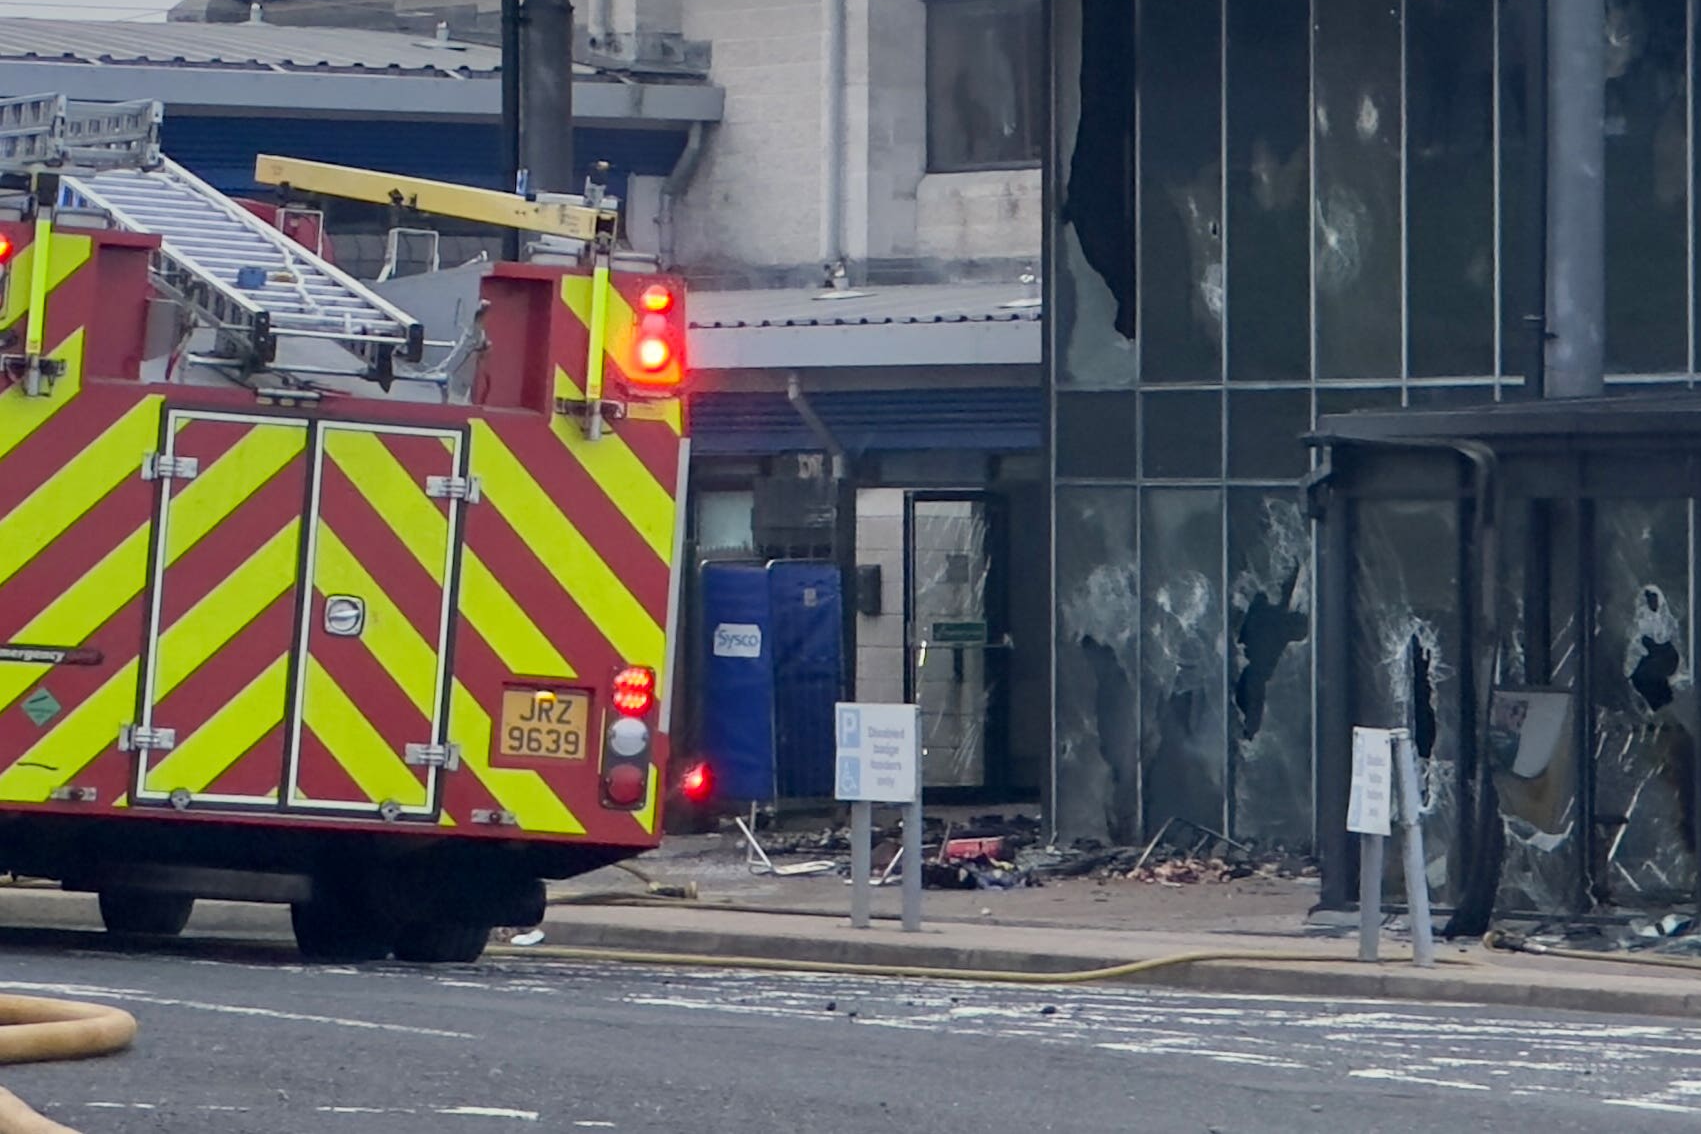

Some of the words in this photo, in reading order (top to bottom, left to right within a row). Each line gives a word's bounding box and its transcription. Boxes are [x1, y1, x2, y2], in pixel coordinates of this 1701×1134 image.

[718, 629, 759, 650] Sysco
[519, 697, 573, 724] JRZ
[508, 726, 580, 755] 9639
